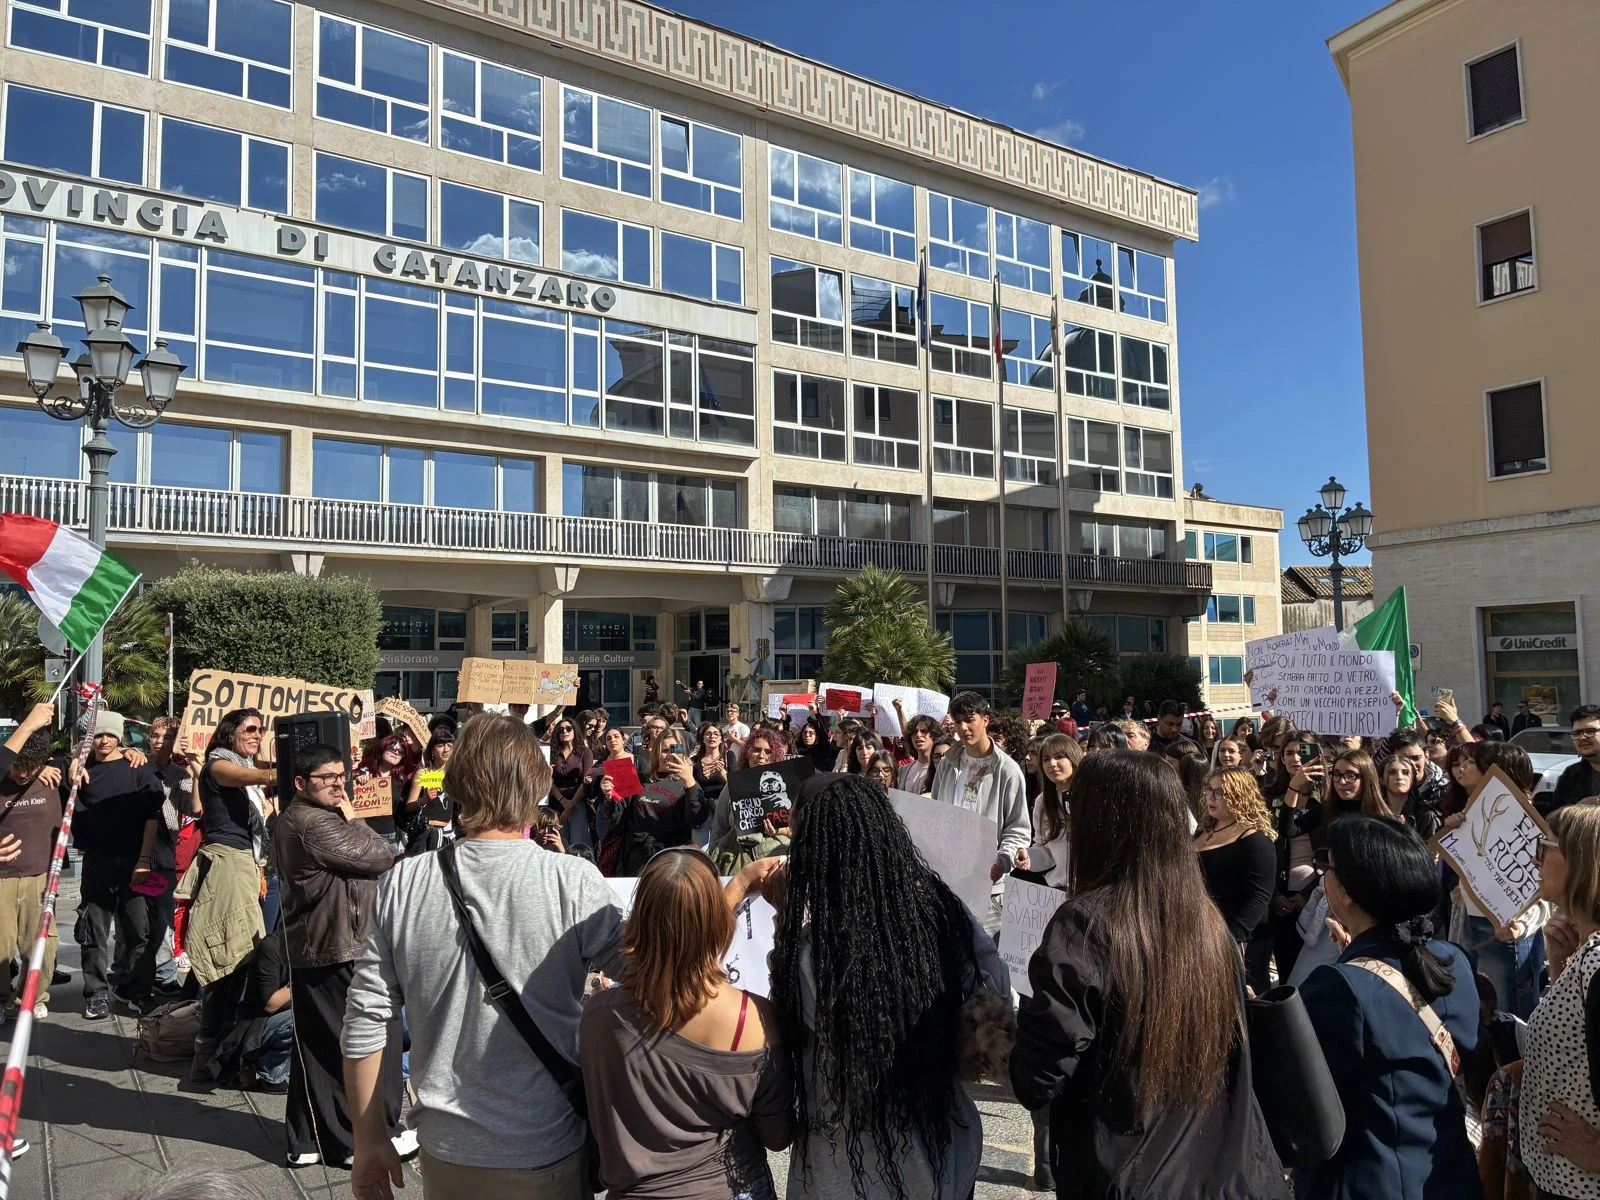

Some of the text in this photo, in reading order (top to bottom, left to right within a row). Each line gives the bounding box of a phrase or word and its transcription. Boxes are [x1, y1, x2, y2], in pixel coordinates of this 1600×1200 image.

[277, 225, 329, 262] DI
[373, 244, 617, 312] CATANZARO
[1514, 636, 1567, 649] UniCredit
[383, 653, 439, 664] Ristorante
[578, 654, 600, 663] delle
[603, 653, 635, 663] Culture
[1277, 654, 1373, 669] QUI TUTTO IL MONDO
[1278, 671, 1305, 682] SEMBRA
[1307, 672, 1330, 683] FATTO
[1333, 671, 1343, 684] DI
[1285, 685, 1300, 694] STA
[1303, 685, 1341, 695] CADENDO
[1345, 687, 1352, 696] A
[191, 674, 363, 725] SOTTOMESSO
[1277, 696, 1296, 707] COME
[1300, 697, 1310, 708] UN
[1313, 697, 1346, 708] VECCHIO
[1347, 696, 1388, 708] PRESEPIO
[1318, 711, 1326, 733] IL
[1328, 711, 1381, 735] FUTURO!
[30, 796, 47, 806] Klein
[732, 797, 762, 811] MEGLIO
[739, 807, 765, 819] PORCO
[1488, 836, 1538, 900] RUDE
[1008, 879, 1020, 902] A
